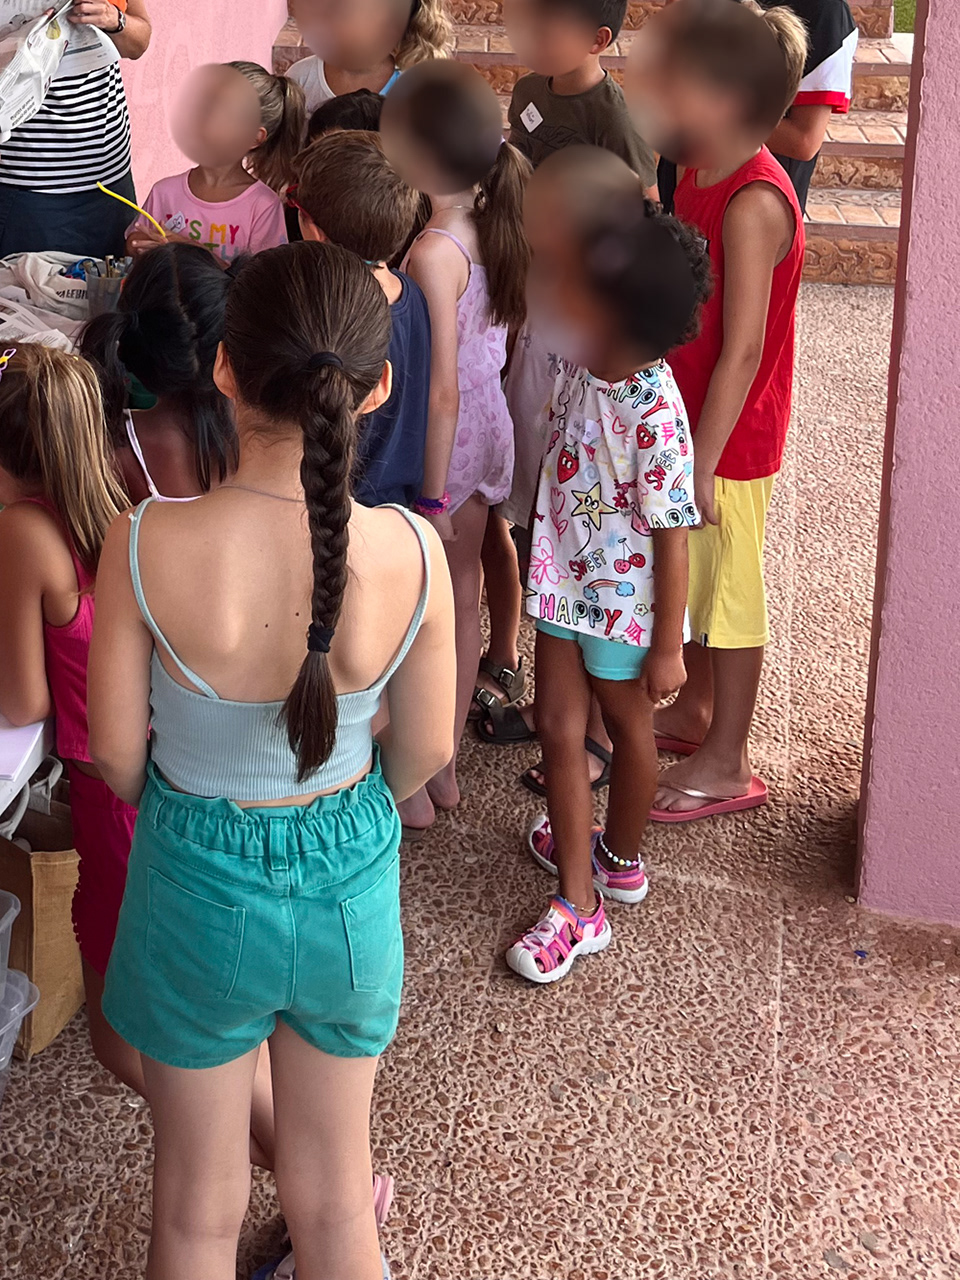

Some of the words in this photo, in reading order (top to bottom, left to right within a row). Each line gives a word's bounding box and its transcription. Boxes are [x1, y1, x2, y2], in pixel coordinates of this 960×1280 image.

[210, 223, 240, 245] MY
[203, 242, 240, 260] TU
[569, 548, 607, 581] SWEET
[540, 593, 623, 636] HAPPY
